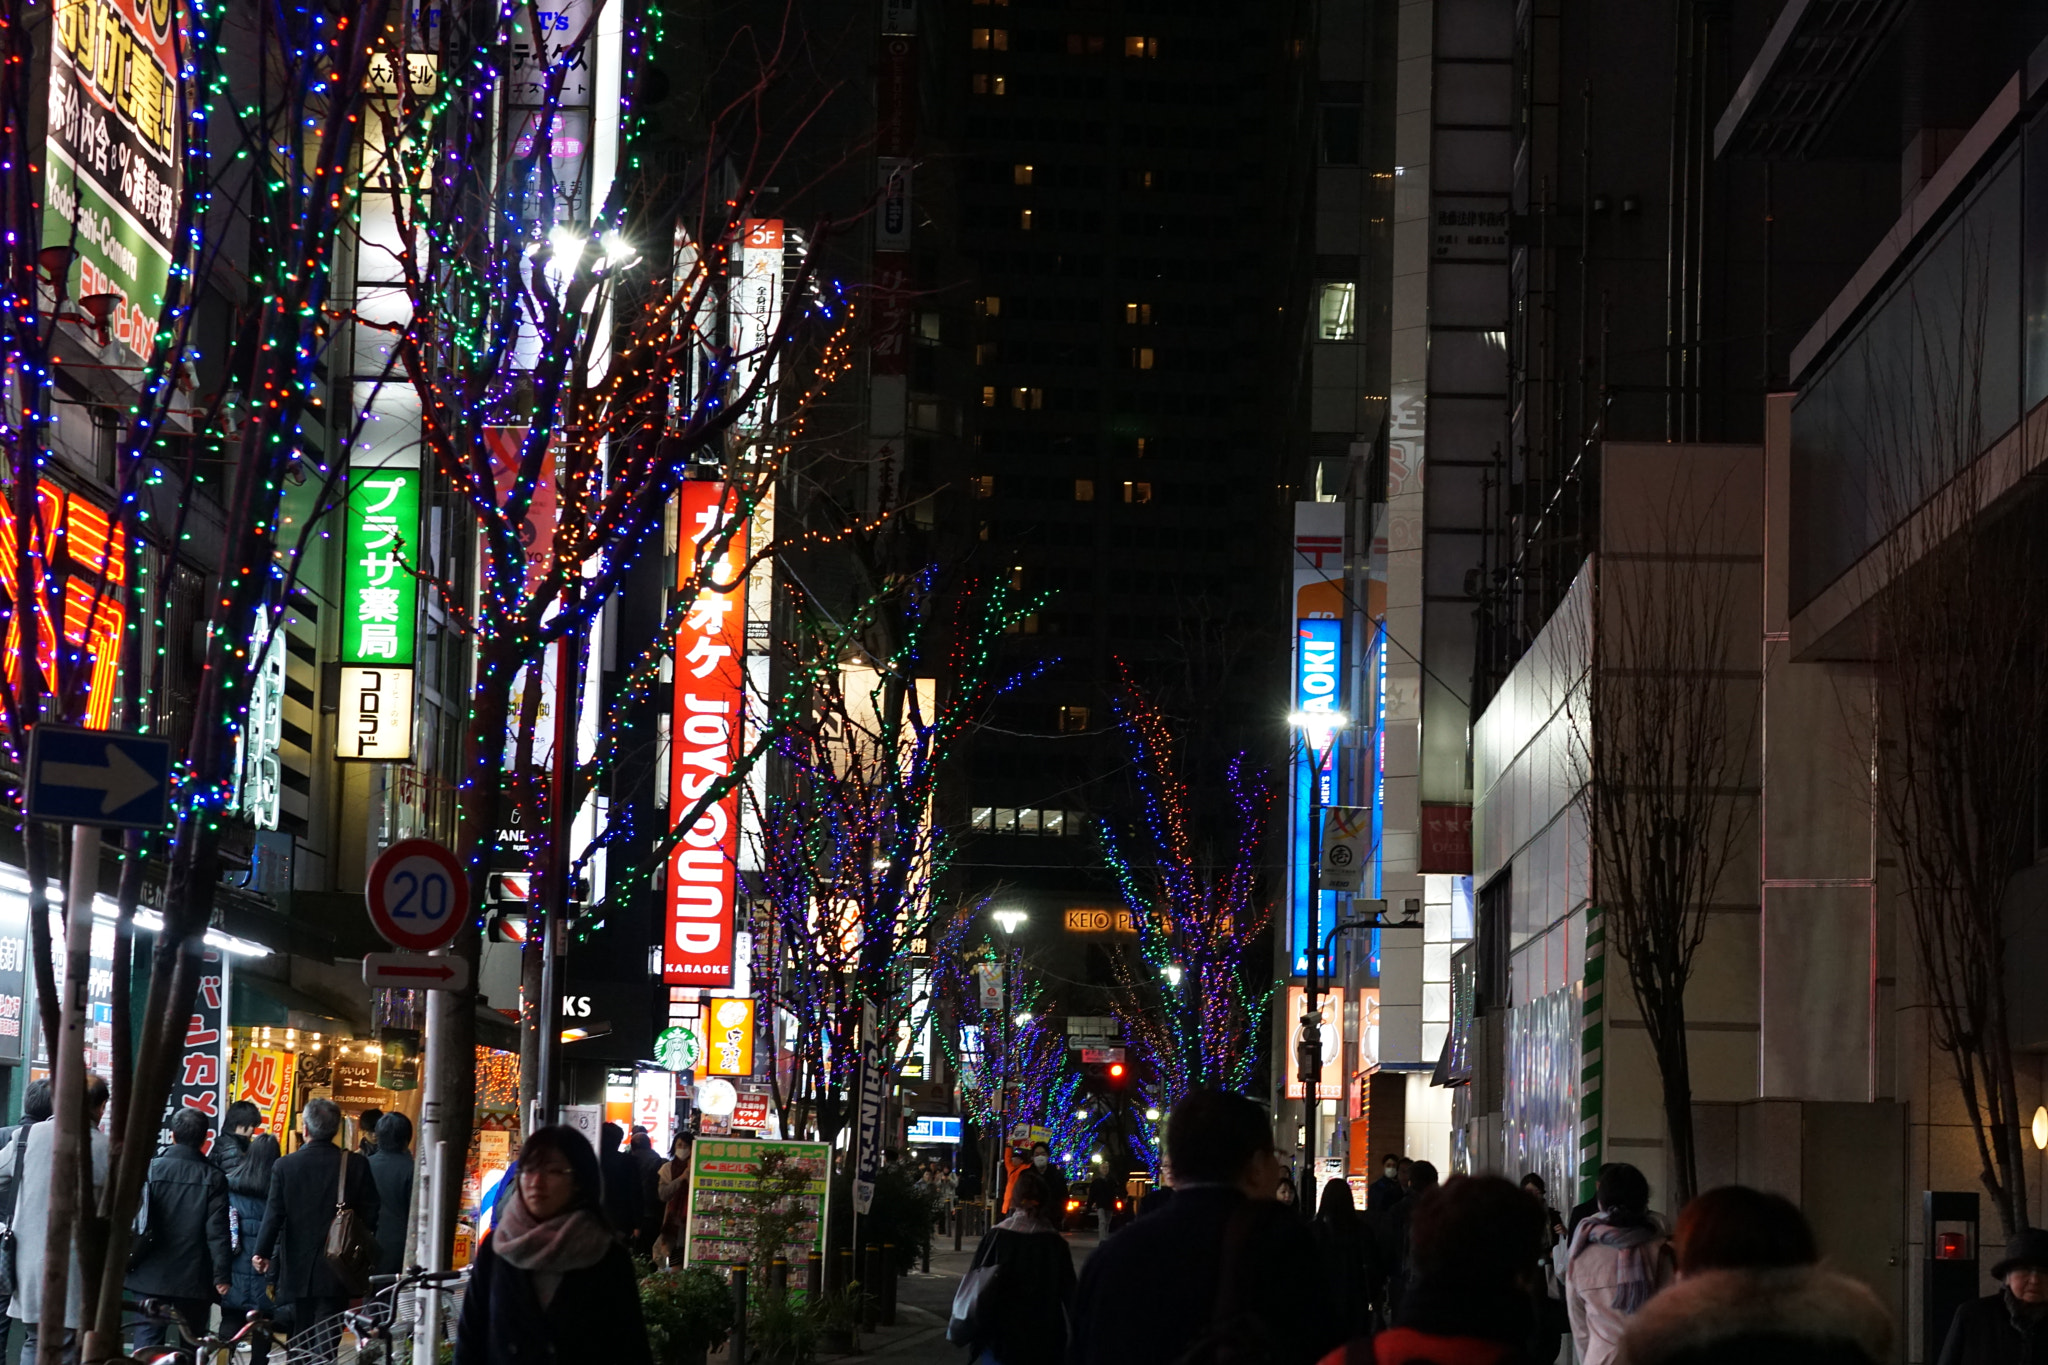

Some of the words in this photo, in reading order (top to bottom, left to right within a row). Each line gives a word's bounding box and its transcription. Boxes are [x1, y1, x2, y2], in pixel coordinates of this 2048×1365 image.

[751, 226, 776, 245] 5F
[358, 476, 406, 659] プラザ薬局
[675, 693, 730, 954] JOYSOUND
[391, 871, 447, 920] 20
[1069, 912, 1109, 929] KEIO
[1118, 912, 1173, 930] PLA
[665, 963, 729, 975] KARAOKE
